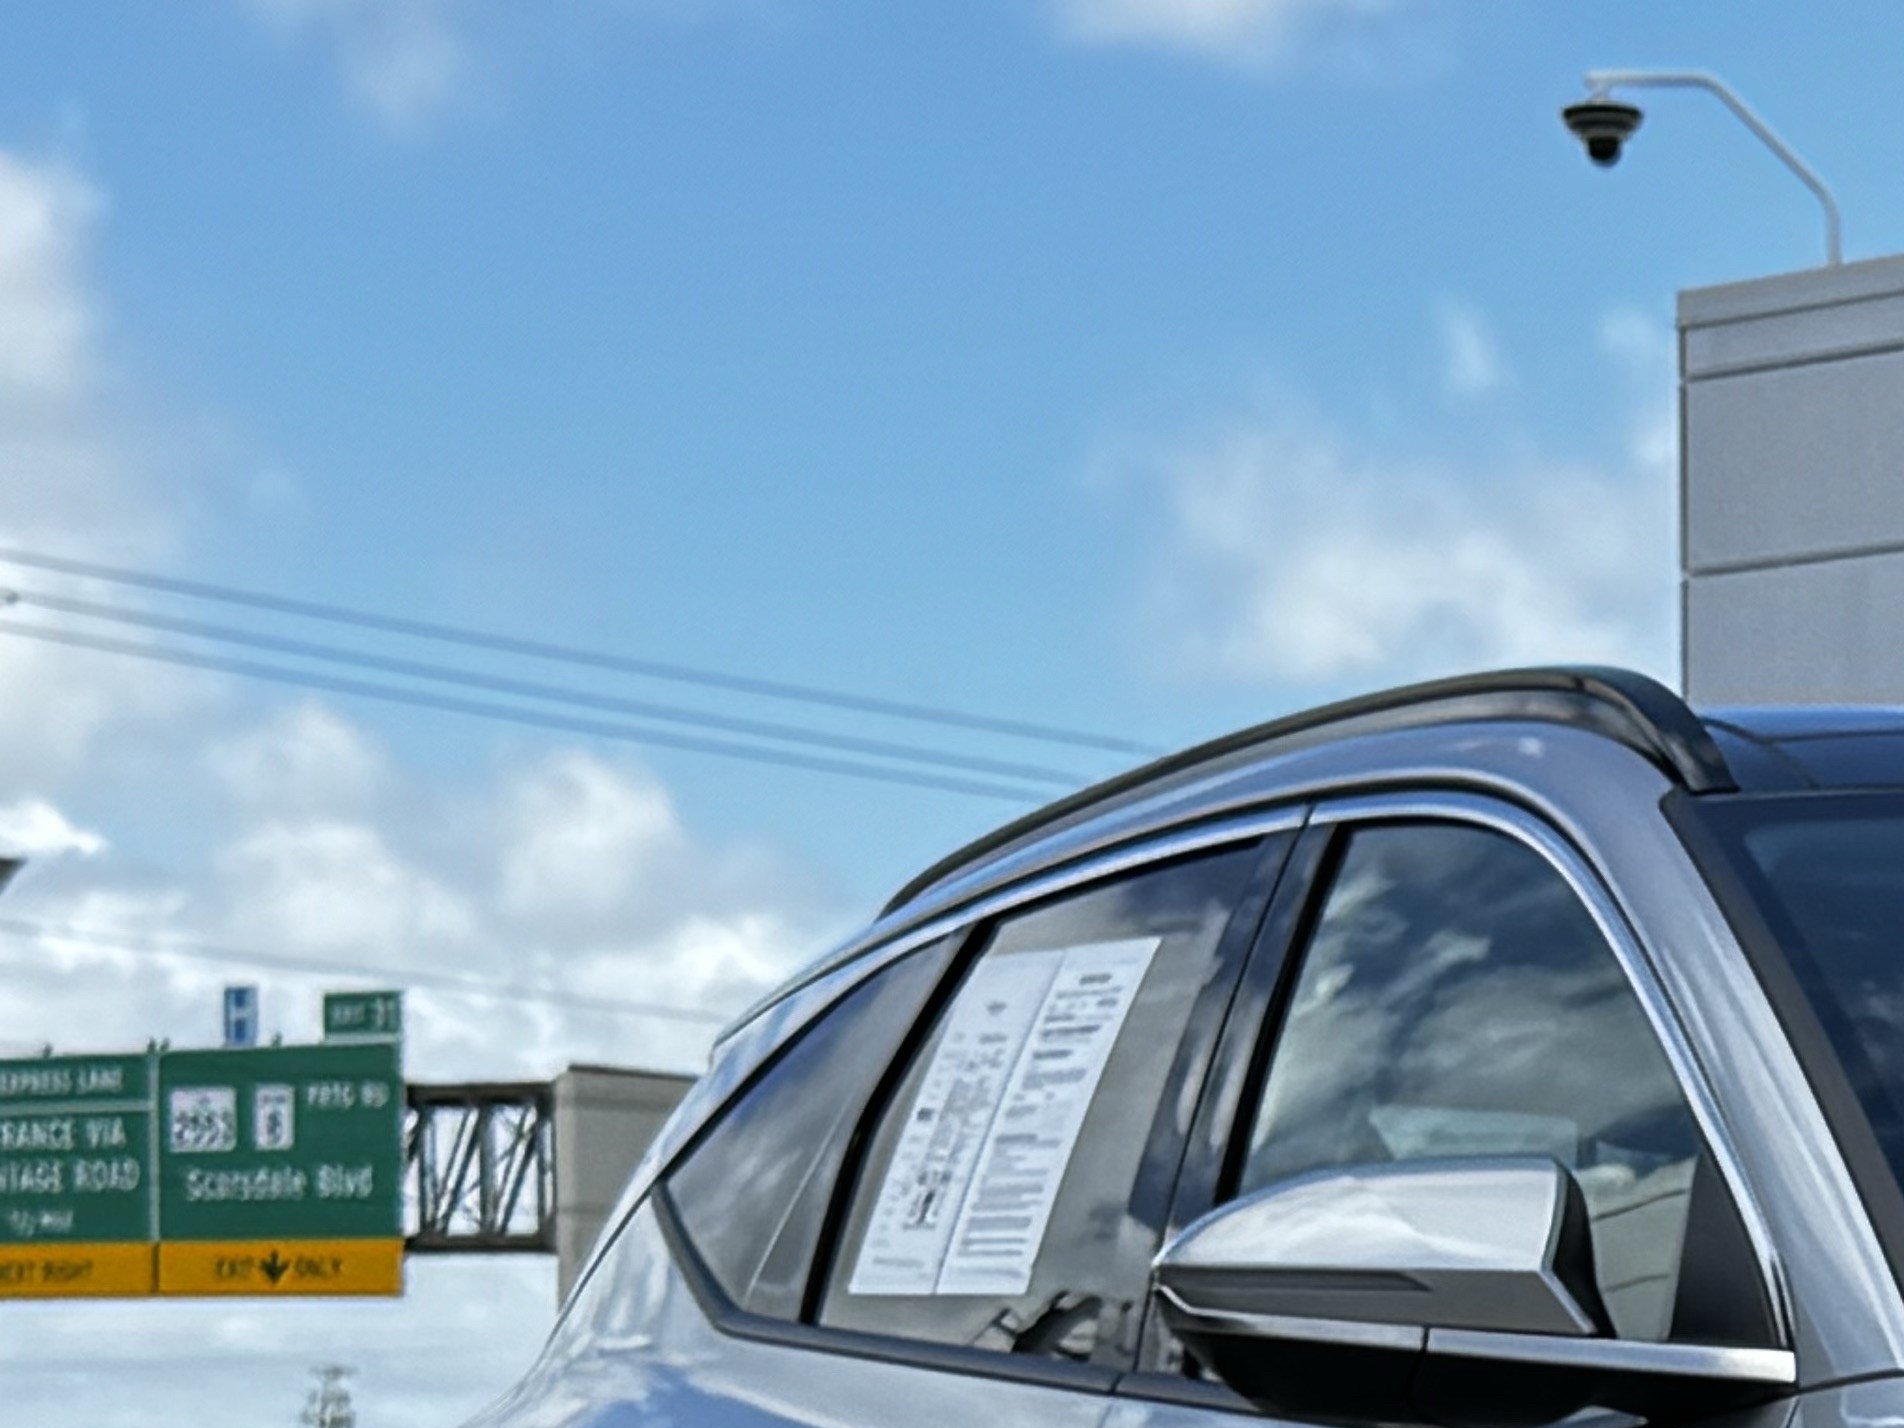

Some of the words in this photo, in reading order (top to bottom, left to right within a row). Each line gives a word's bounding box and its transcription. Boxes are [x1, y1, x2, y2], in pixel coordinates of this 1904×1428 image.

[77, 1064, 123, 1094] LANE
[86, 1115, 127, 1148] VIA
[73, 1155, 141, 1192] ROAD
[317, 1163, 373, 1198] Blvd
